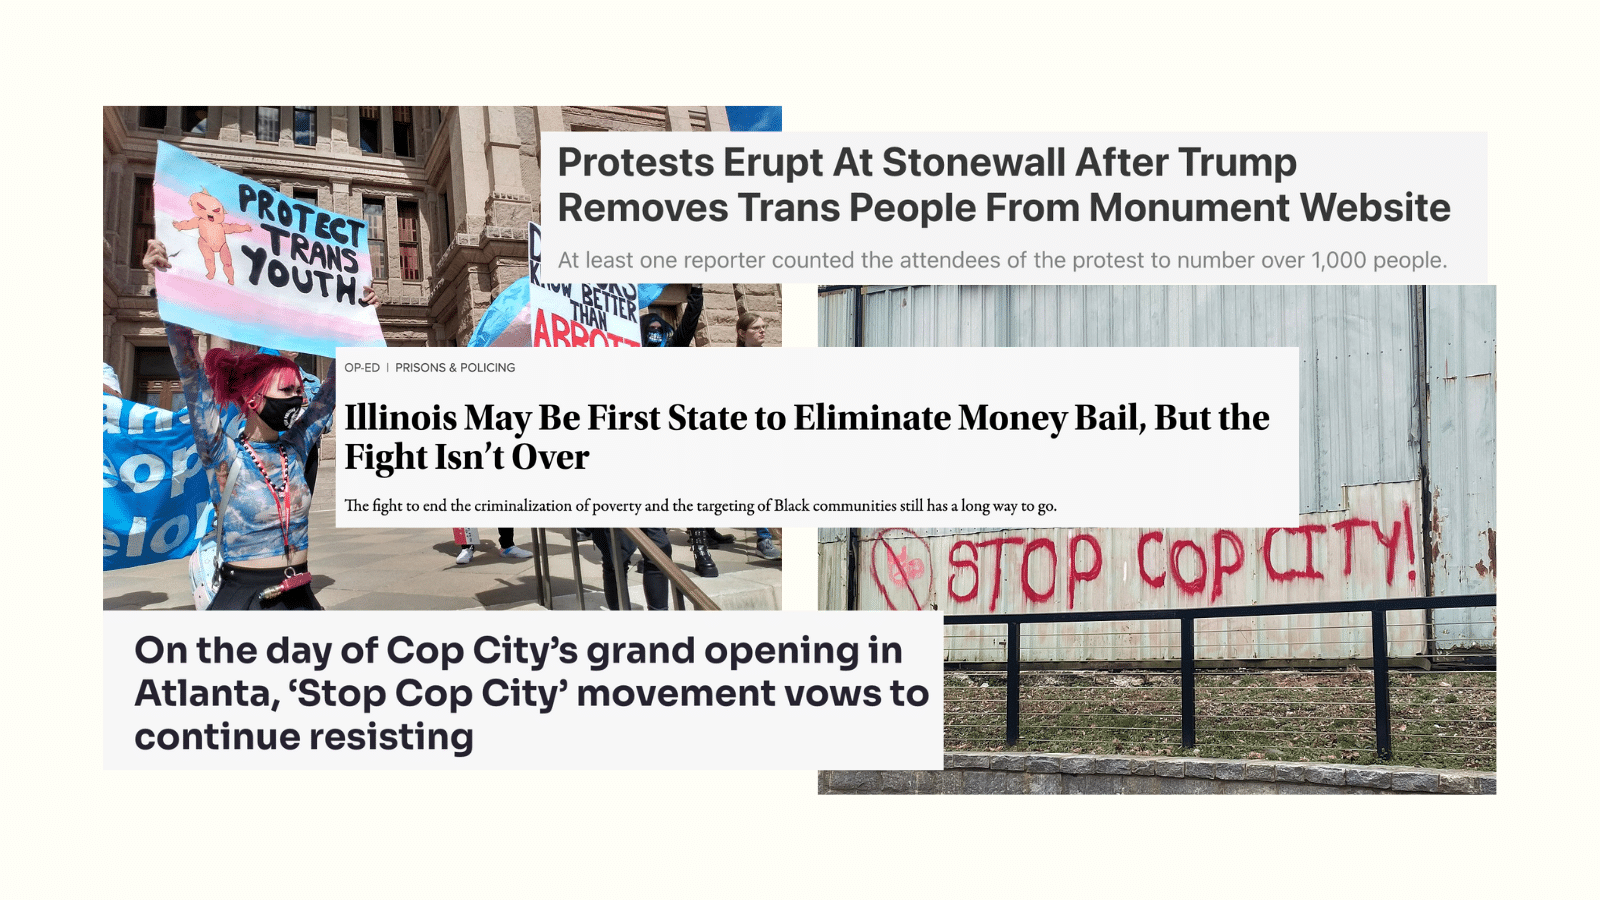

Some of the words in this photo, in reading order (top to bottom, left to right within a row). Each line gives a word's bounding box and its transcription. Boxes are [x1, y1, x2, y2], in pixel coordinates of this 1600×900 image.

[238, 183, 366, 248] PROTECT
[260, 222, 359, 274] TRANS
[569, 298, 608, 332] THAN
[581, 283, 638, 324] BETTER
[948, 533, 1103, 613] STOP
[1138, 530, 1245, 606] COP
[1263, 499, 1417, 588] CITY!
